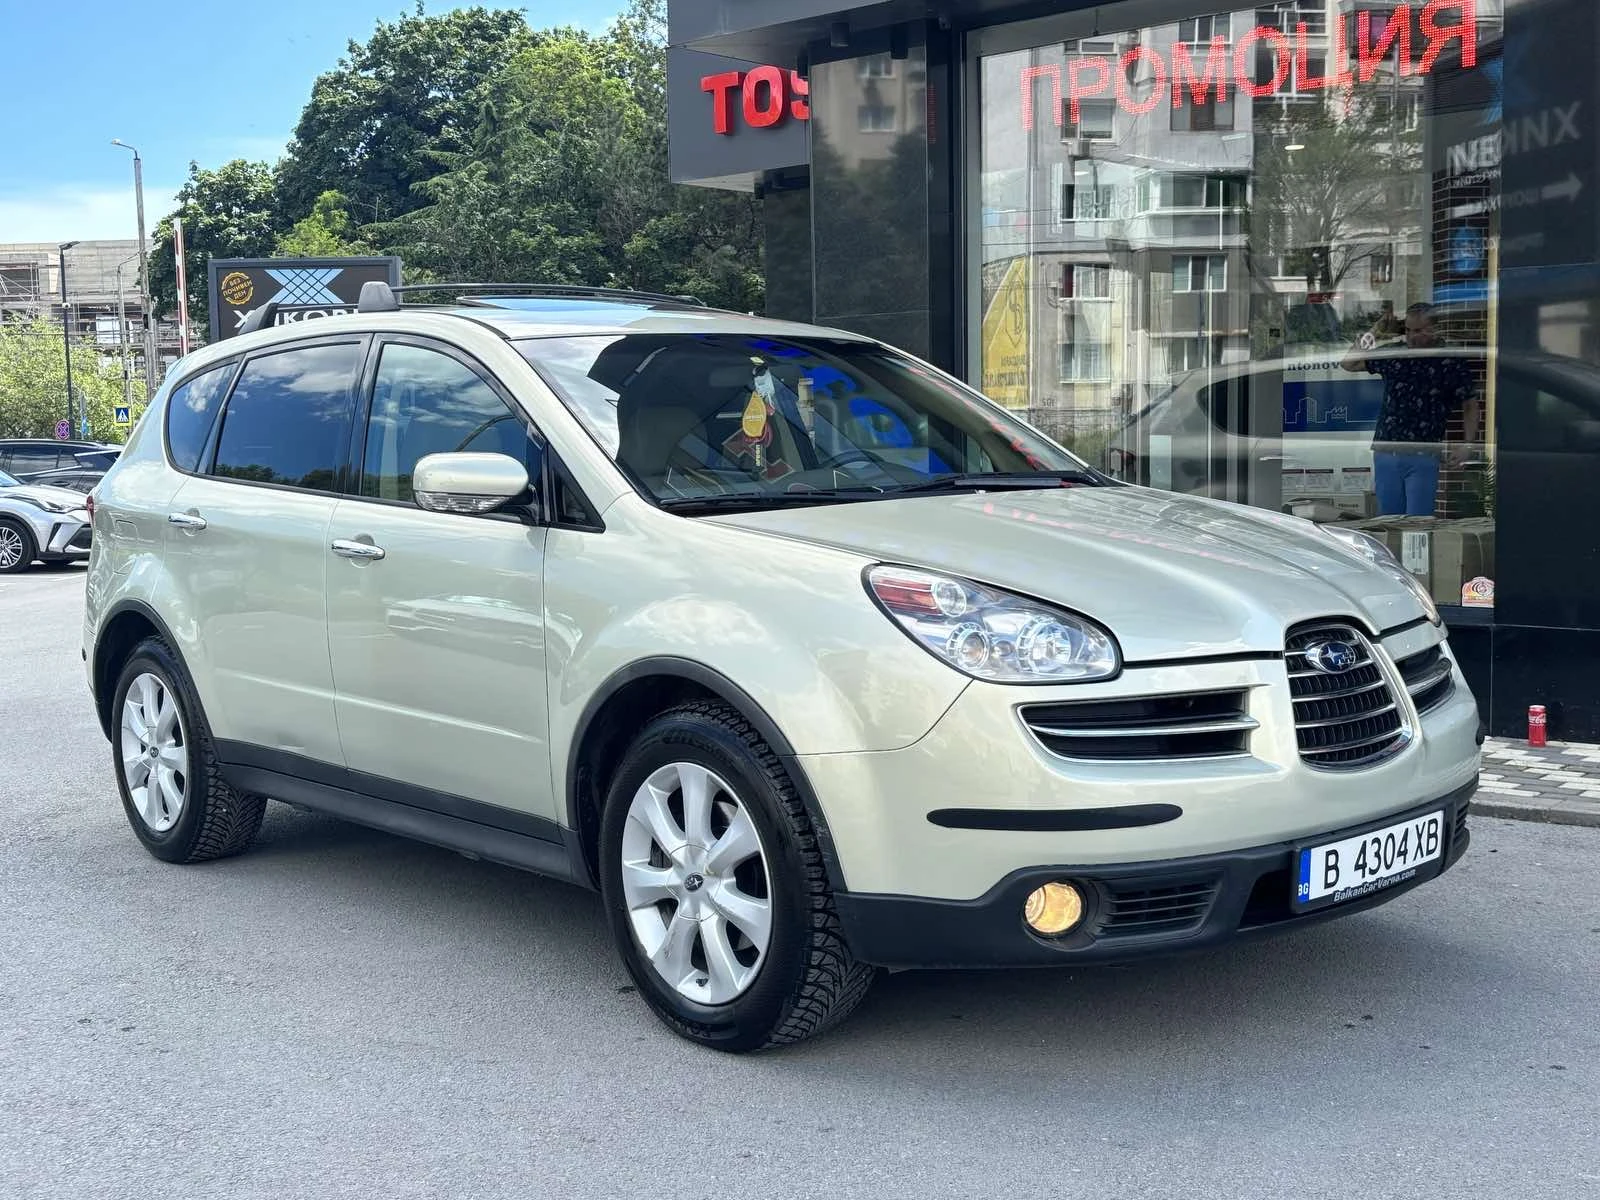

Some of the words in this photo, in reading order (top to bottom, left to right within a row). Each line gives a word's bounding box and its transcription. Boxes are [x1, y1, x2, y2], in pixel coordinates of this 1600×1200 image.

[1019, 0, 1477, 131] ПРОМОЦИЯ
[1323, 849, 1340, 890] B
[1354, 827, 1409, 878] 4304
[1413, 817, 1439, 862] XB
[1298, 882, 1309, 896] BG
[1333, 868, 1416, 902] BalkanCarVarna.com
